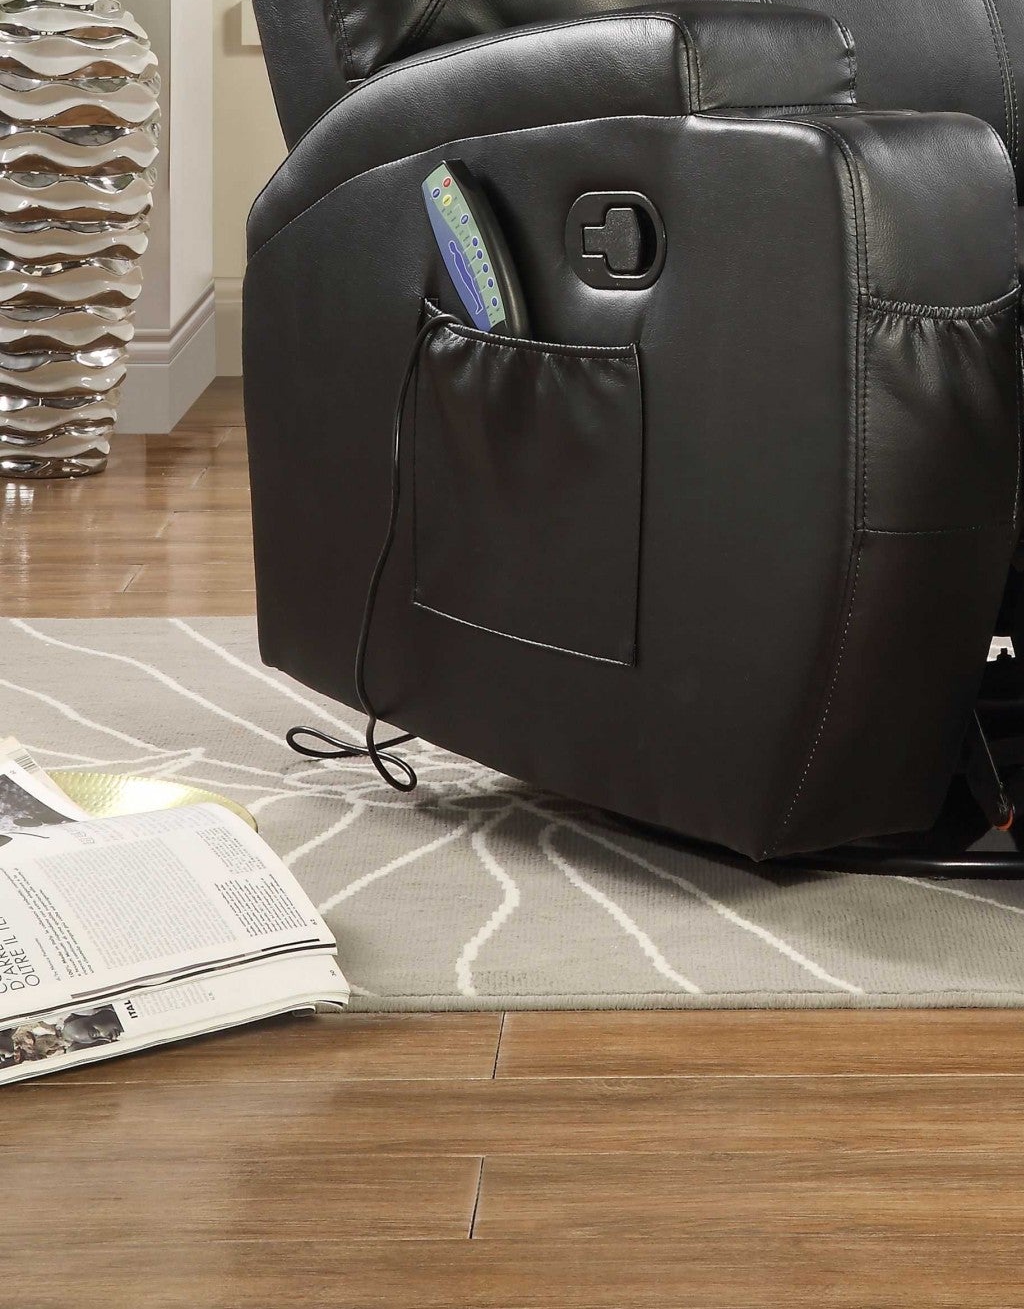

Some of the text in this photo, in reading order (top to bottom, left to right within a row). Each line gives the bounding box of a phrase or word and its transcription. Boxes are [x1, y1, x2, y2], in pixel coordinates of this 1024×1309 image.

[3, 935, 18, 945] IL
[9, 948, 40, 987] OLTRE
[123, 999, 139, 1020] ITAL
